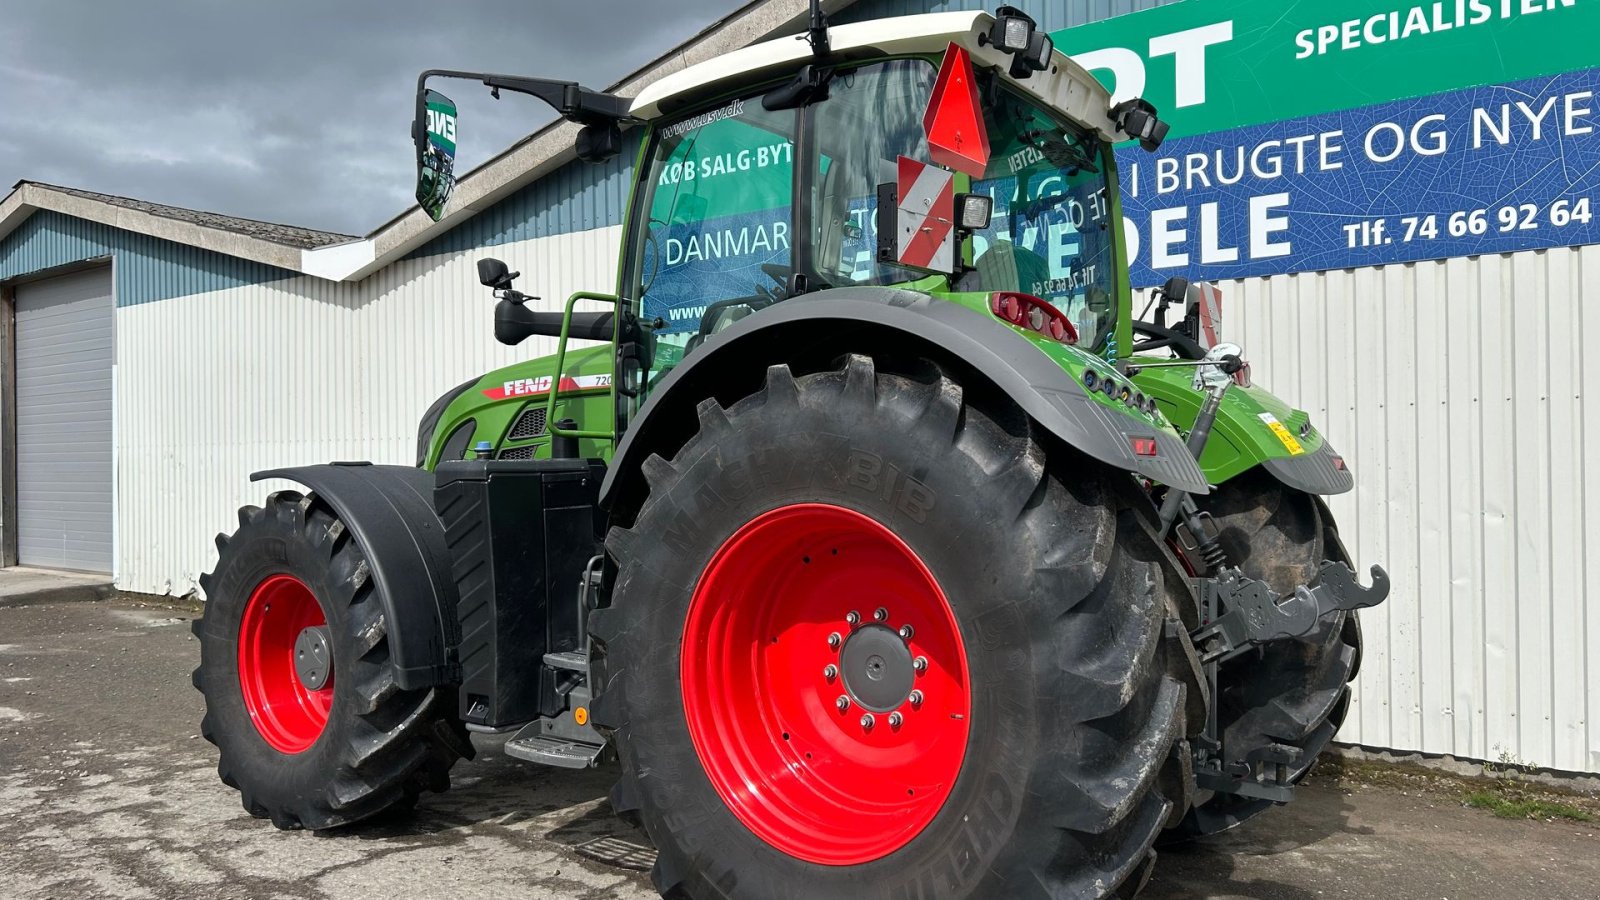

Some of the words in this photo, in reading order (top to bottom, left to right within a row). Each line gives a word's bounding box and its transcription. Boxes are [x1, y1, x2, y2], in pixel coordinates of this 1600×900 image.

[662, 98, 745, 140] www.usv.dk
[1131, 165, 1139, 198] I
[1156, 130, 1343, 195] BRUGTE
[1363, 113, 1447, 164] OG
[1472, 90, 1593, 150] NYE
[1343, 221, 1392, 249] Tlf.
[1402, 213, 1439, 244] 74
[1447, 208, 1487, 237] 66
[1498, 201, 1539, 232] 92
[1549, 196, 1593, 227] 64
[503, 373, 566, 397] FEND
